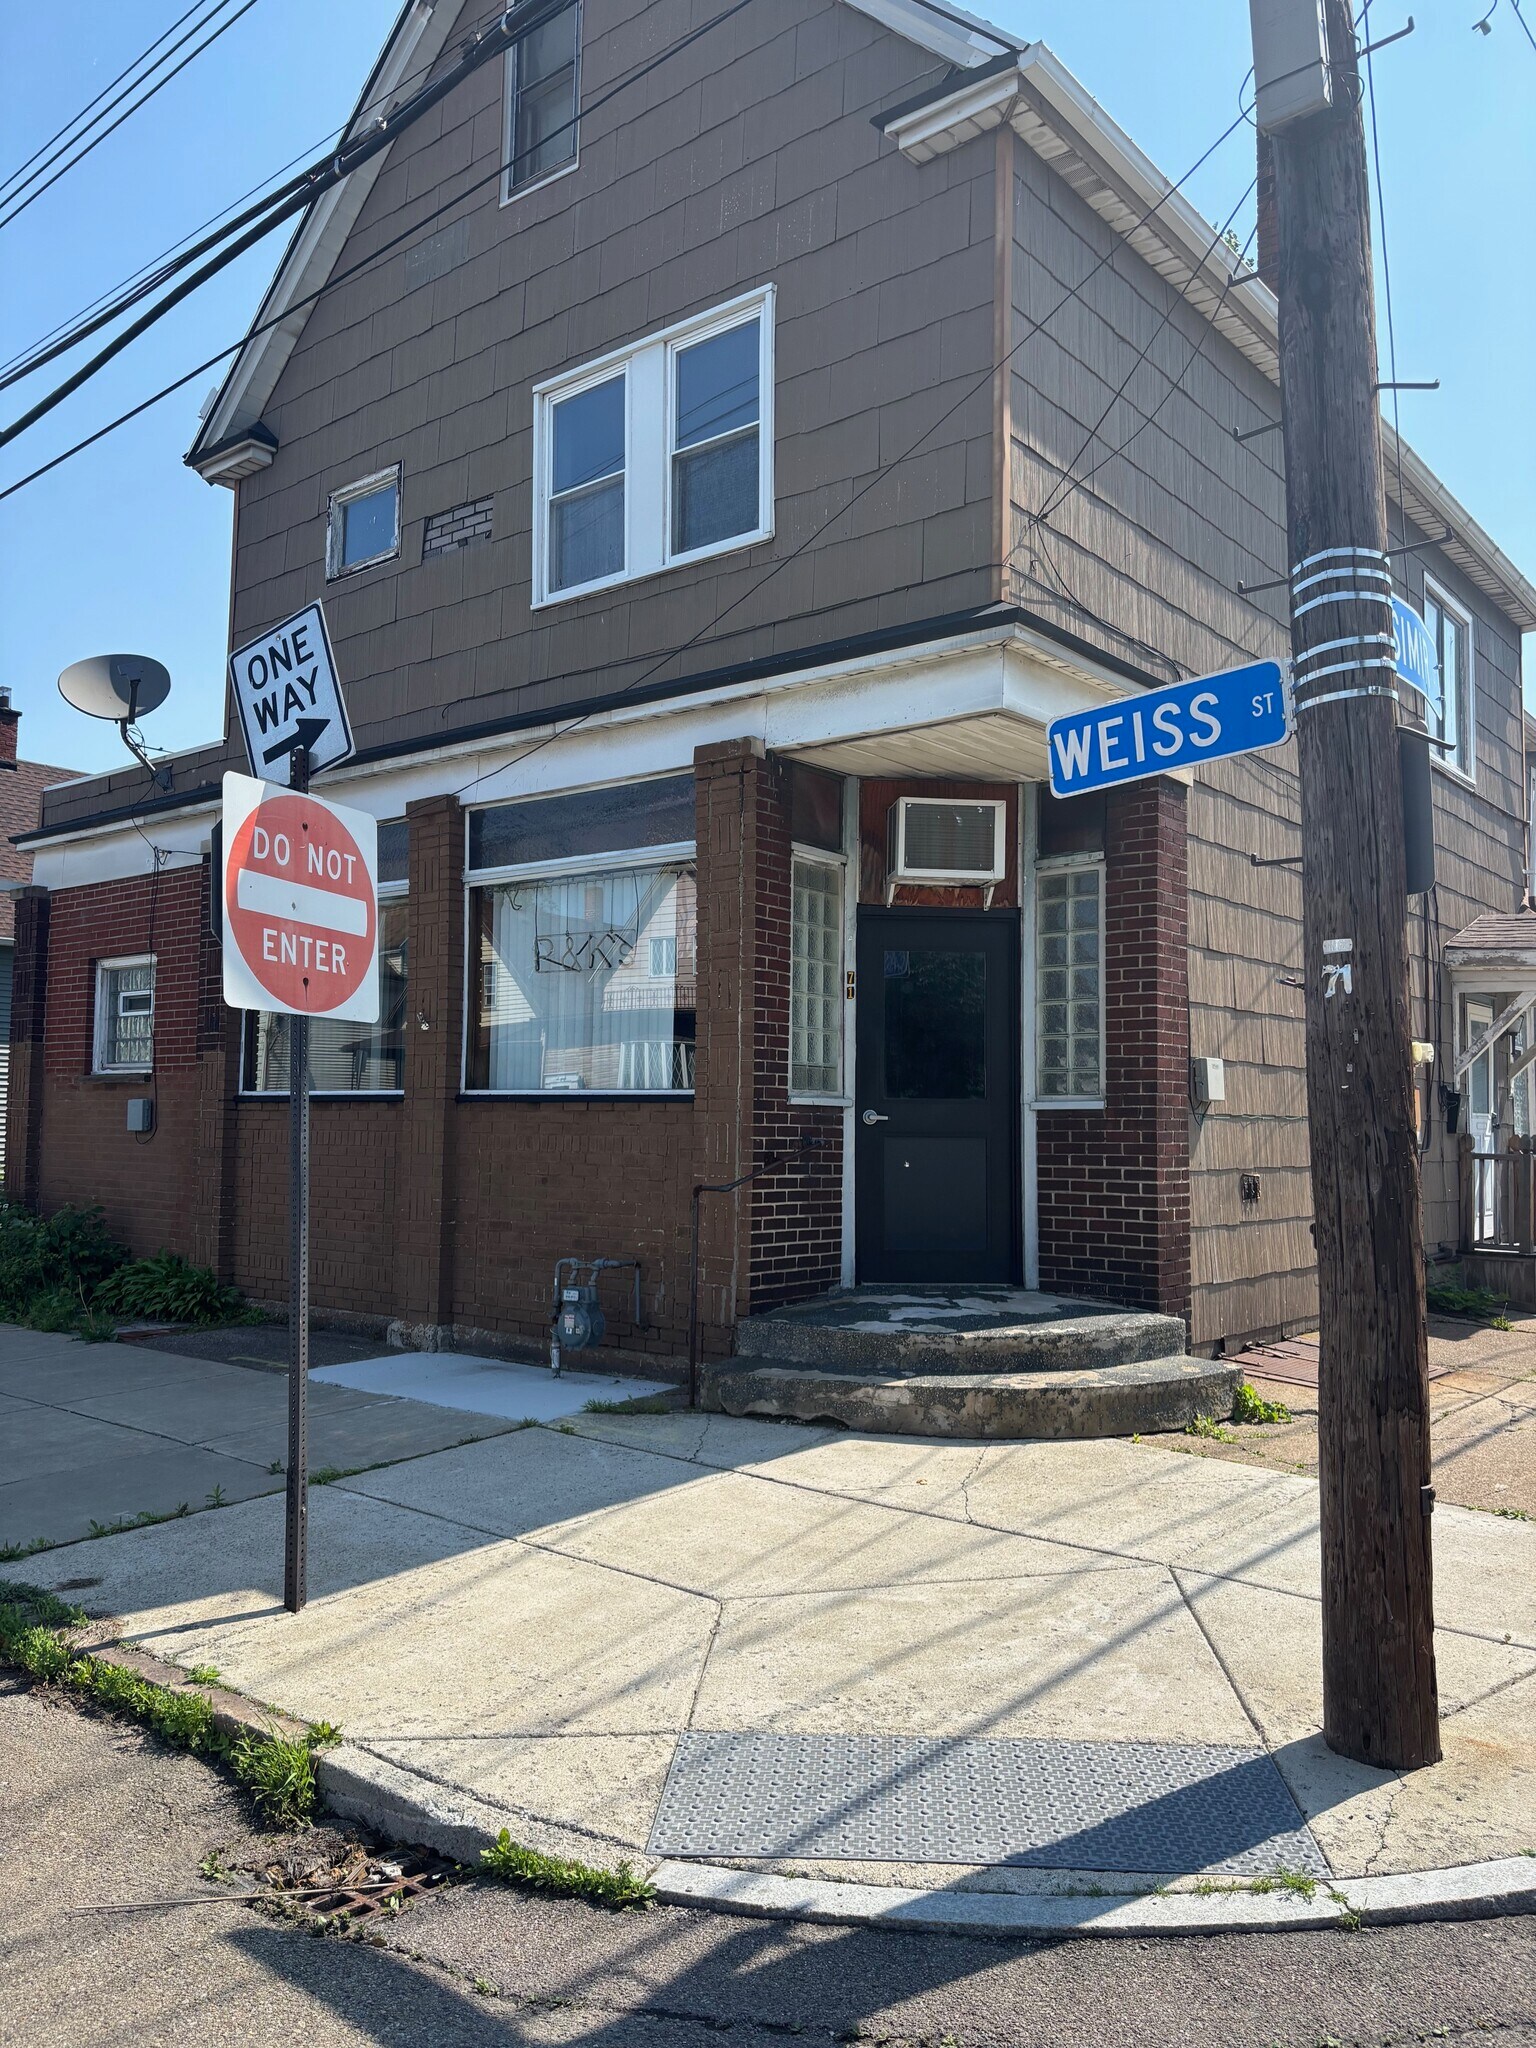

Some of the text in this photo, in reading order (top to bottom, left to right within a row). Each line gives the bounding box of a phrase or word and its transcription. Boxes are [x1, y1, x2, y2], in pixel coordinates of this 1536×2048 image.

[248, 625, 314, 691] ONE
[253, 665, 319, 735] WAY
[1053, 692, 1274, 781] WEISS ST
[253, 826, 357, 884] DO NOT
[263, 928, 347, 975] ENTER
